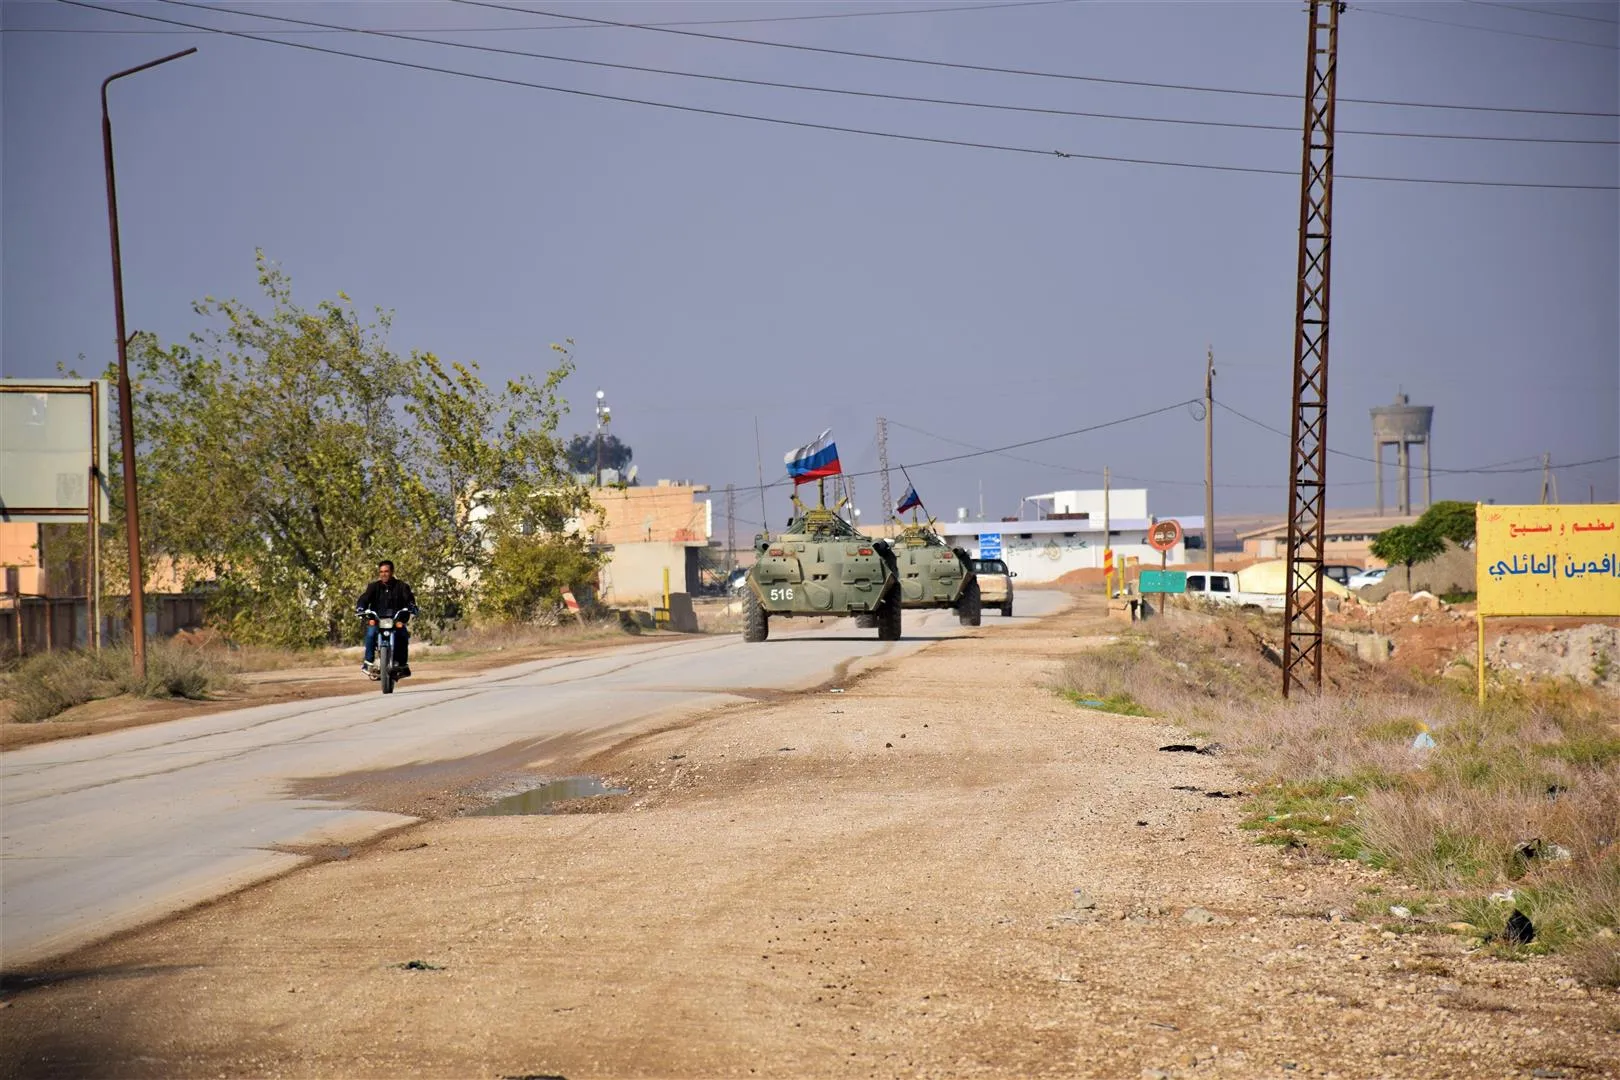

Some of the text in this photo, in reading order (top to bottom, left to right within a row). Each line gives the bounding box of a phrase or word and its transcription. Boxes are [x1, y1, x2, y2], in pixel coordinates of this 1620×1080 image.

[1510, 519, 1615, 538] مطعم و مسبح
[1489, 553, 1620, 581] افدين العائلي
[770, 588, 794, 601] 516
